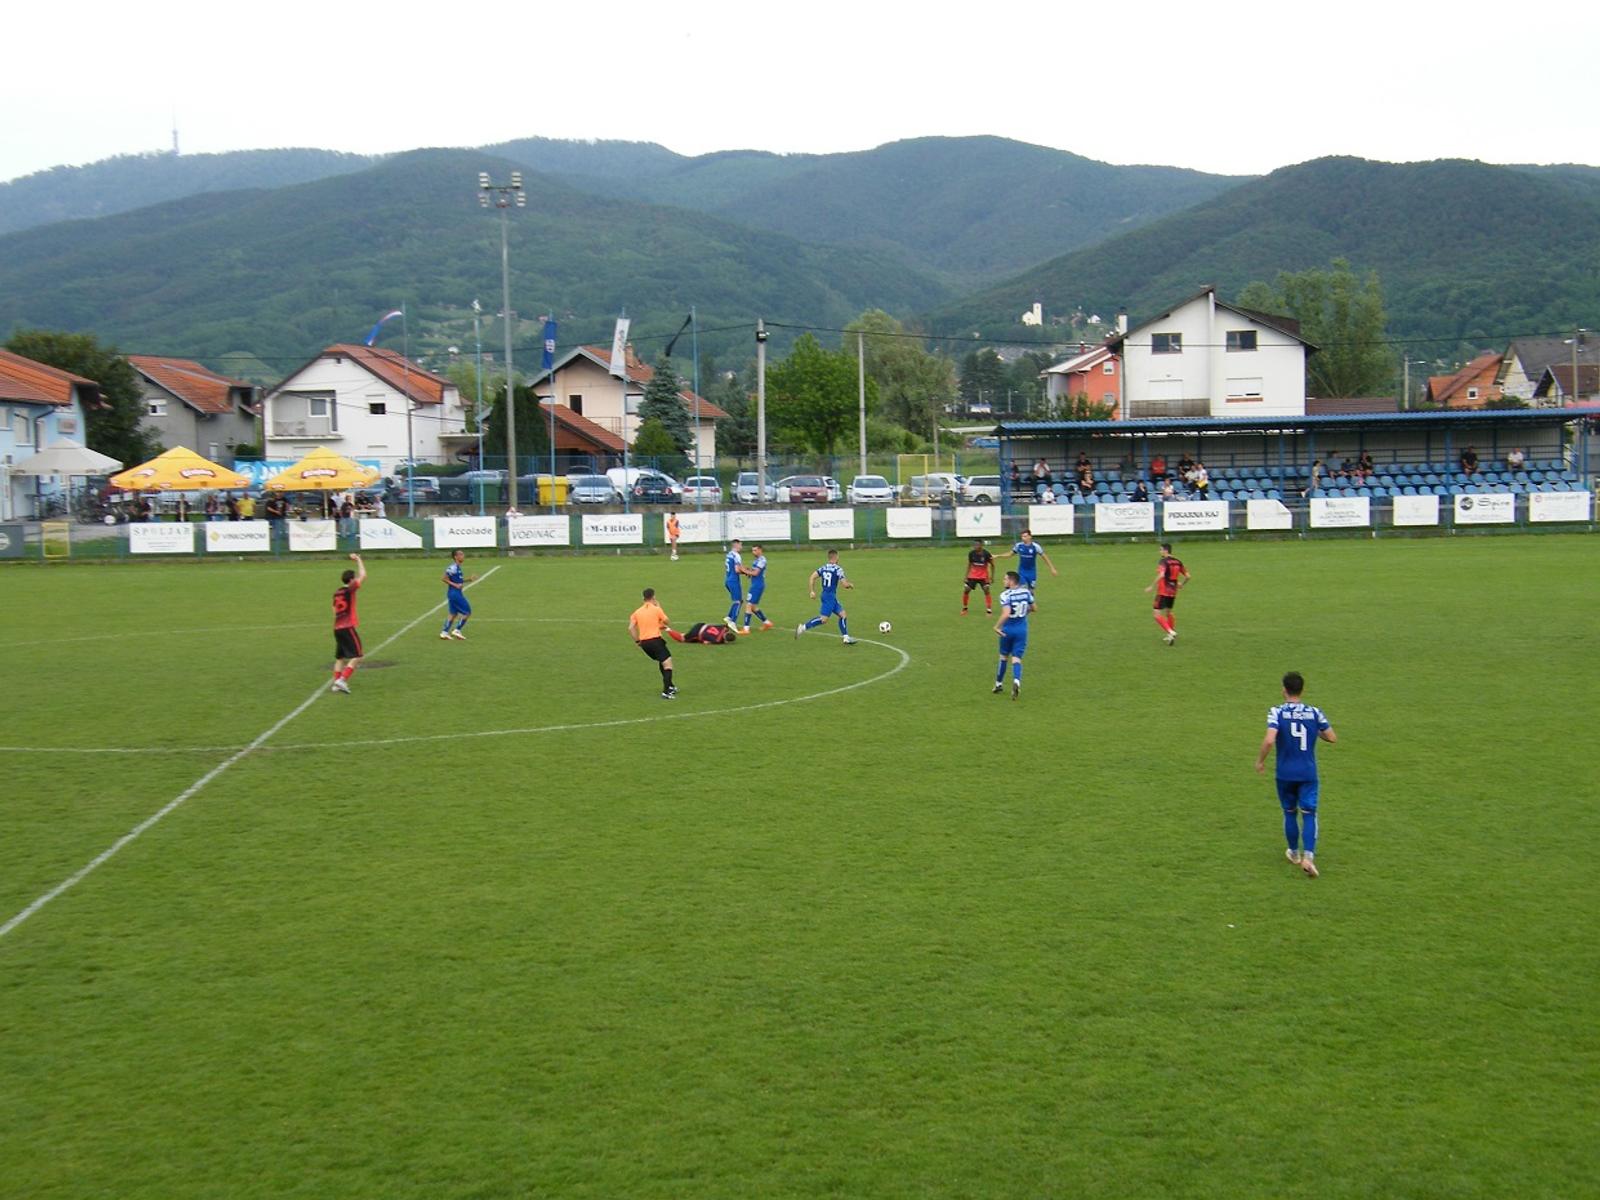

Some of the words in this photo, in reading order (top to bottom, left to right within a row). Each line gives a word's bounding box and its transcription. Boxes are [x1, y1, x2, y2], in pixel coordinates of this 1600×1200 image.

[448, 527, 492, 536] Accolade
[1010, 601, 1029, 618] 30
[1290, 722, 1307, 751] 4
